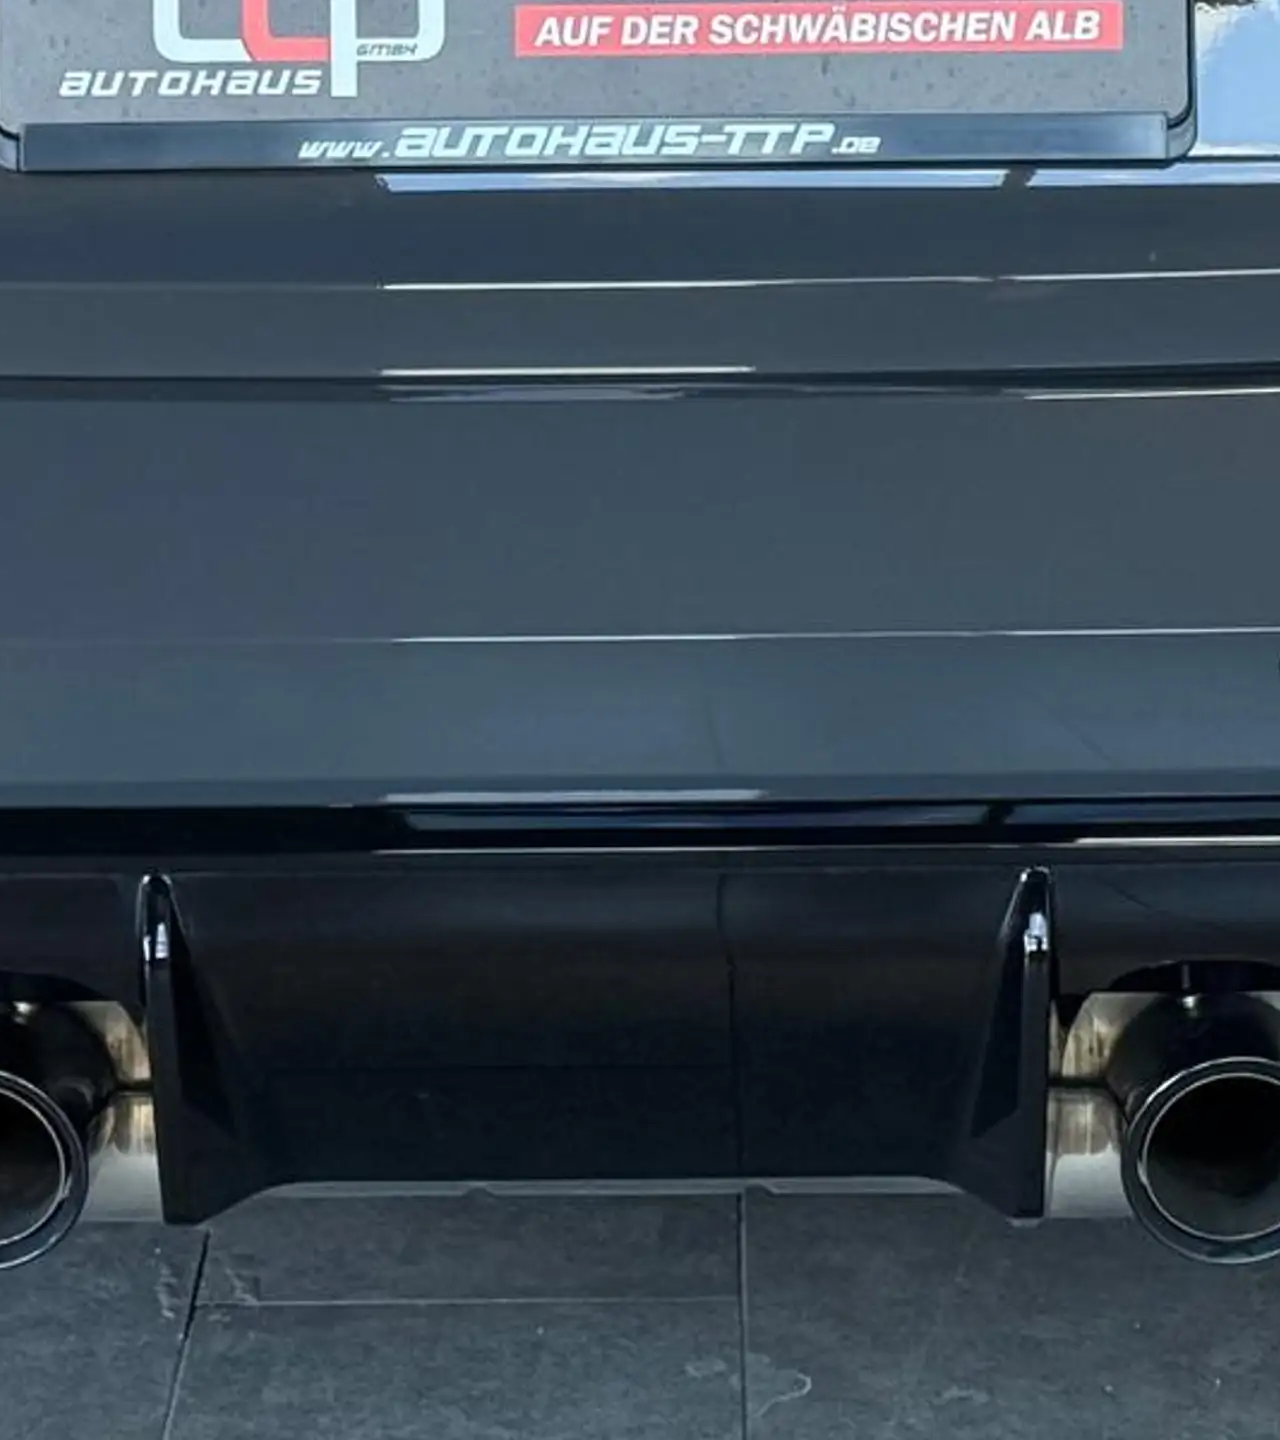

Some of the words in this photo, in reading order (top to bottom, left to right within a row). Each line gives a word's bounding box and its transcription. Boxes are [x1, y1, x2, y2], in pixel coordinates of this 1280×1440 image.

[534, 17, 613, 47] AUF
[621, 15, 701, 46] DER
[709, 6, 1017, 44] SCHWÄBISCHEN
[1025, 10, 1101, 41] ALB
